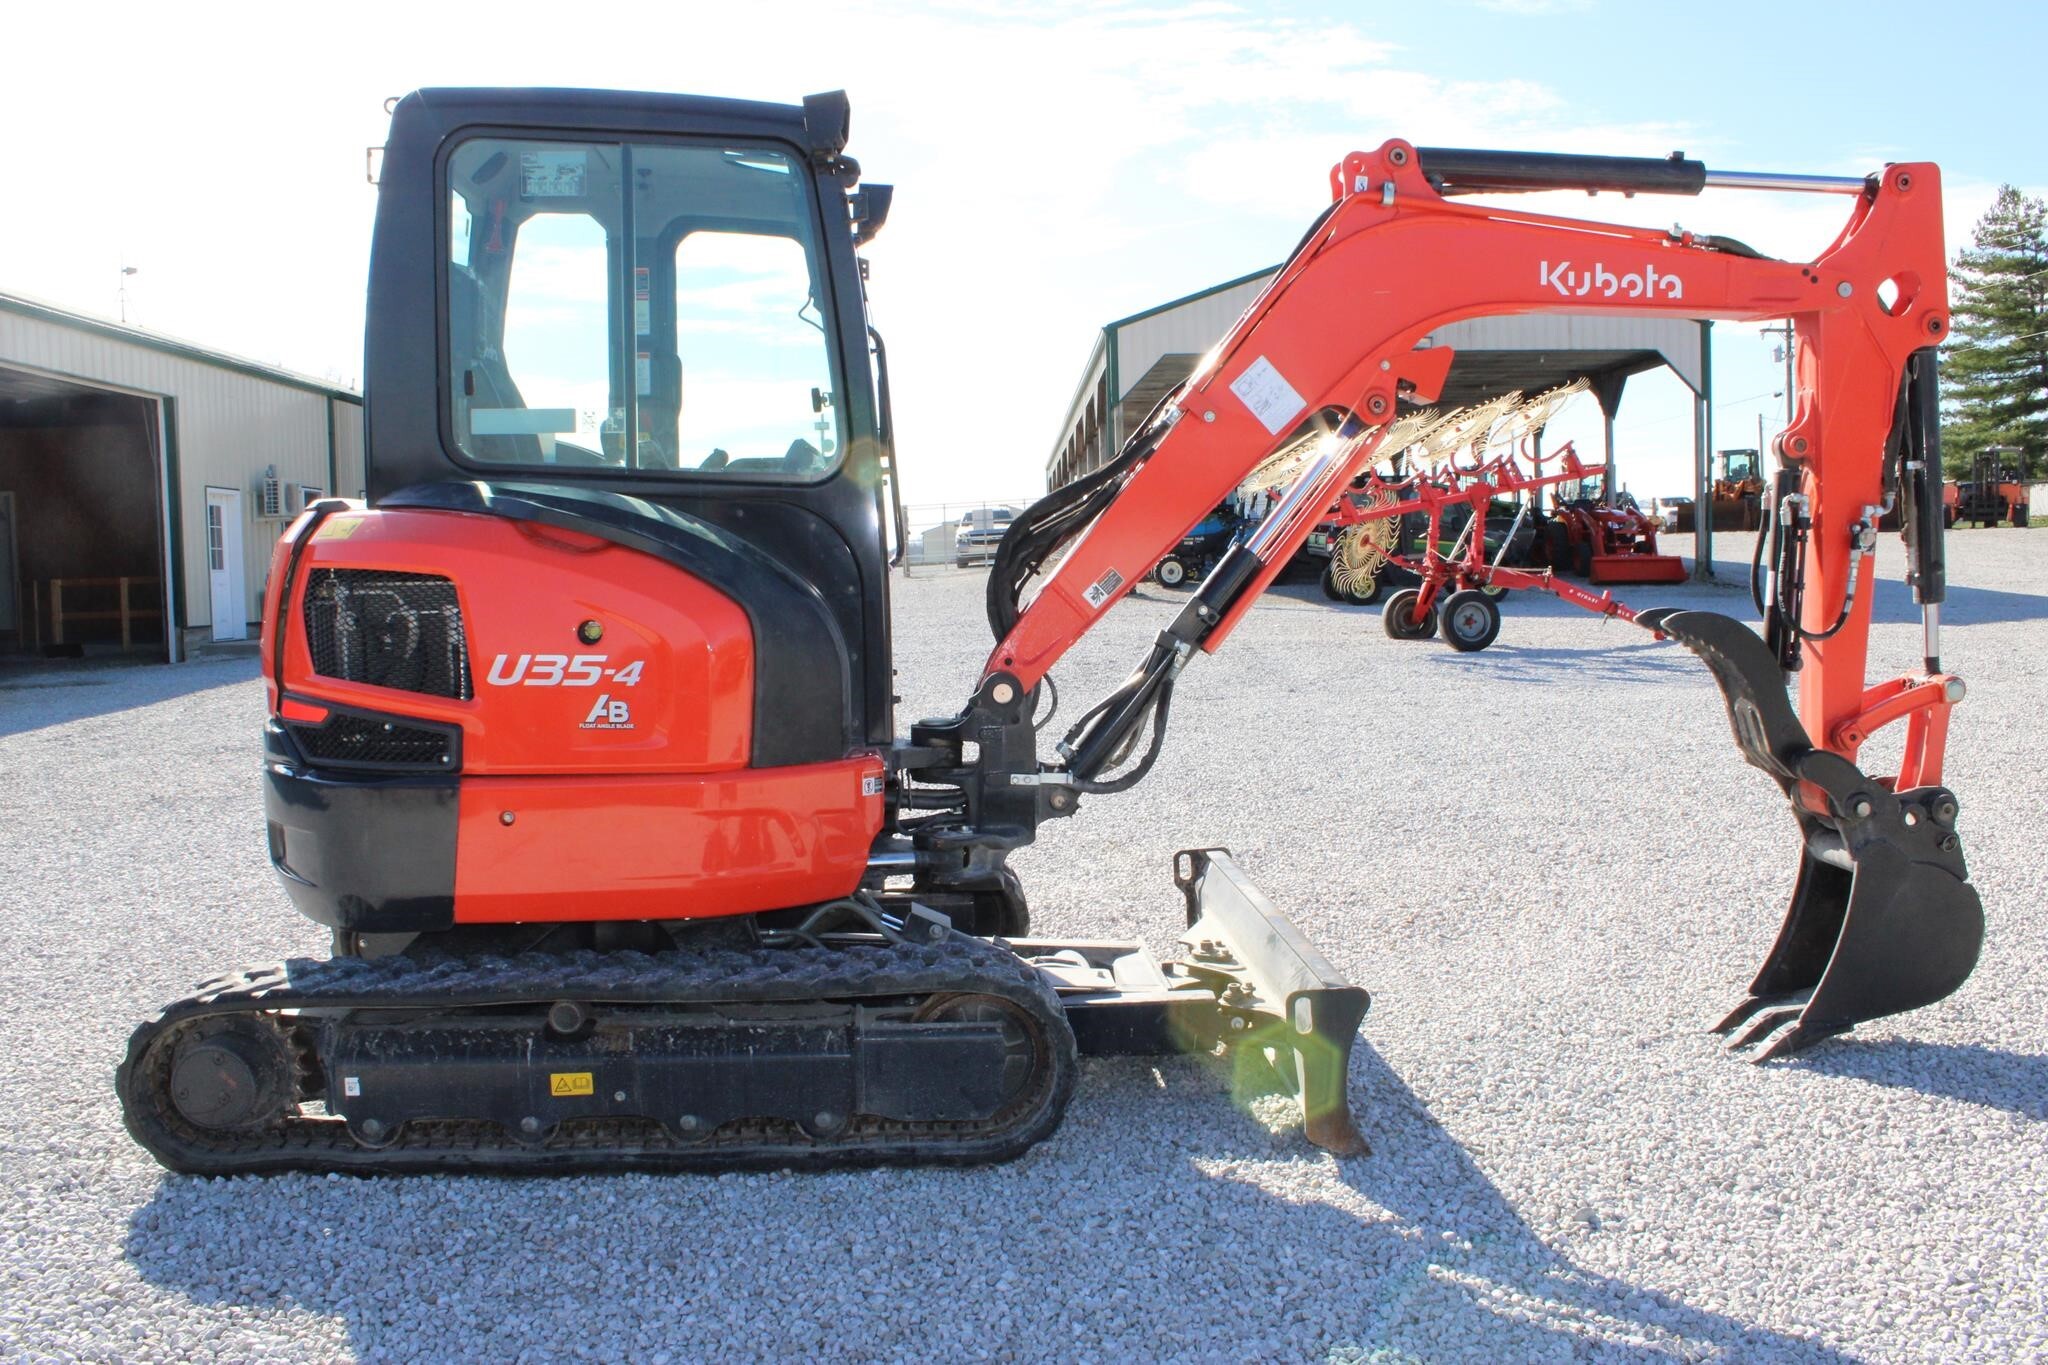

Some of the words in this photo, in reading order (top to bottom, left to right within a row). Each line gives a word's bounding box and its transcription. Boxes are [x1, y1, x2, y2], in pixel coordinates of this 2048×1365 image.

[1540, 261, 1682, 299] Kubota
[486, 654, 645, 687] U35-4
[585, 694, 630, 723] AB
